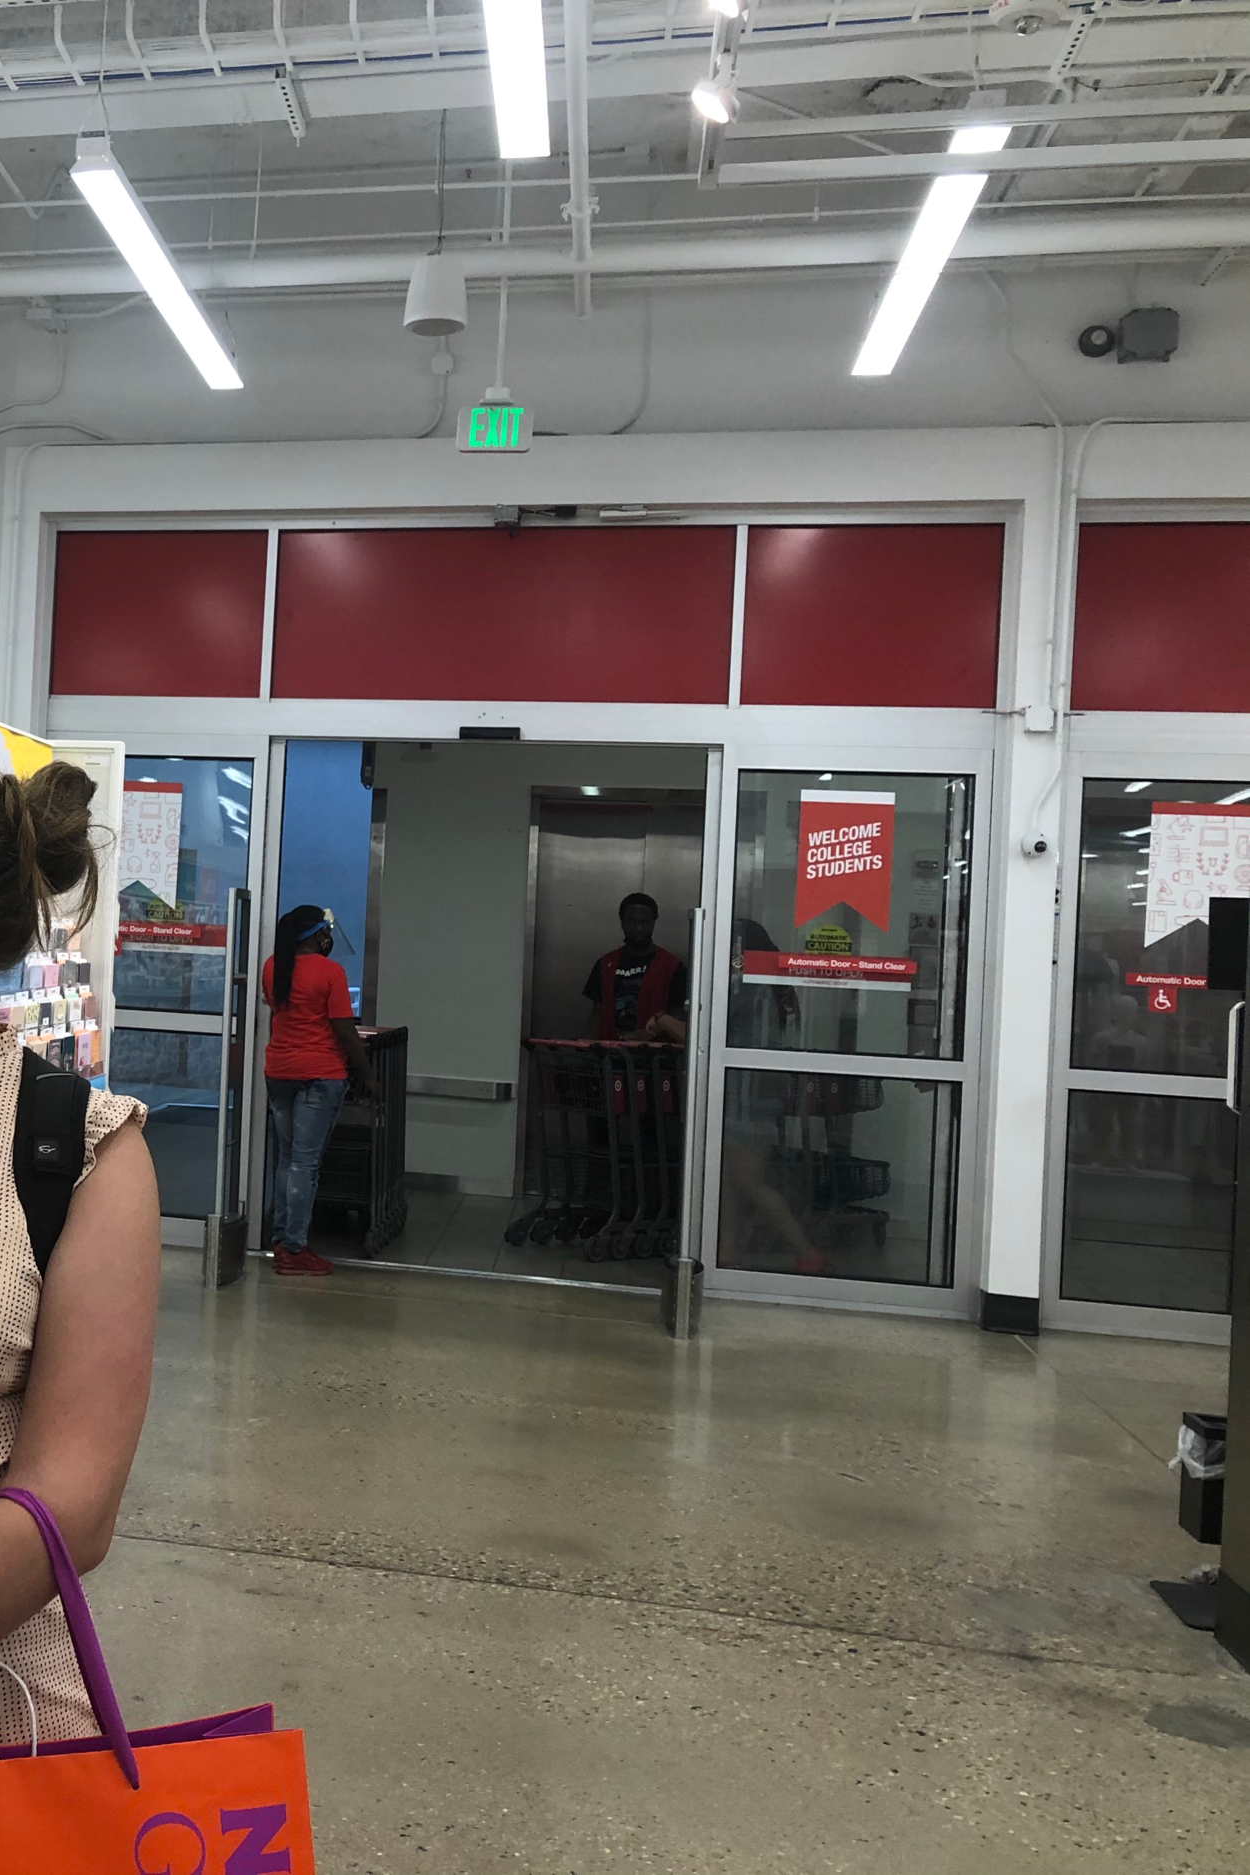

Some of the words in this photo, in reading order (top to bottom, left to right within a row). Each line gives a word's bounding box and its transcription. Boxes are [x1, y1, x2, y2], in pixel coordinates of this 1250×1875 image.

[469, 408, 524, 447] EXIT
[808, 822, 882, 847] WELCOME
[807, 840, 872, 863] COLLEGE
[806, 855, 883, 880] STUDENTS
[152, 926, 173, 934] Stand
[810, 933, 848, 941] AUTOMATIC
[807, 942, 850, 951] CAUTION
[787, 957, 829, 967] Automatic
[830, 958, 851, 968] Door
[858, 960, 883, 970] Stand
[884, 962, 907, 971] Clear
[835, 969, 864, 978] OPEN
[1136, 975, 1182, 985] Automatic
[1183, 977, 1207, 986] Door
